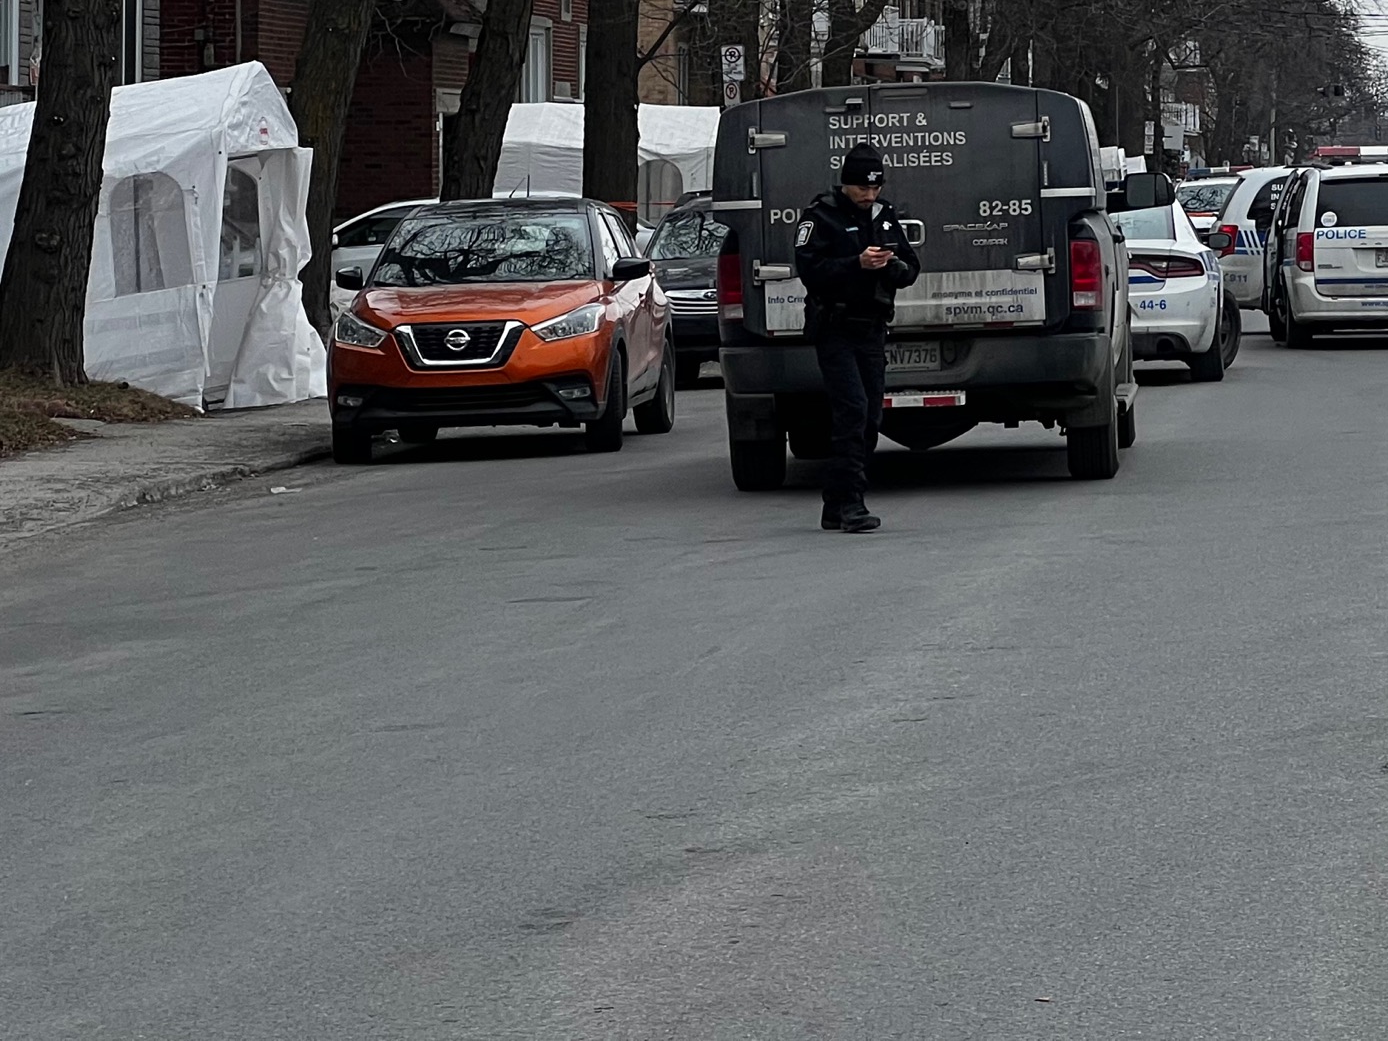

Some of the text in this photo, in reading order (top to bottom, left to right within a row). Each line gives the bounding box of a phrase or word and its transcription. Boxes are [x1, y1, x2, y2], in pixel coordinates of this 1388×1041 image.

[829, 113, 927, 129] SUPPORT &
[829, 131, 966, 149] INTERVENTIONS
[830, 149, 953, 169] SALISÉES
[979, 199, 1033, 216] 82-85
[1316, 229, 1367, 240] POLICE
[985, 287, 1038, 297] confidentiel
[768, 295, 785, 304] Info
[1139, 299, 1167, 310] 44-6
[945, 303, 1024, 316] spvm.qc.ca
[885, 348, 937, 364] NV7376
